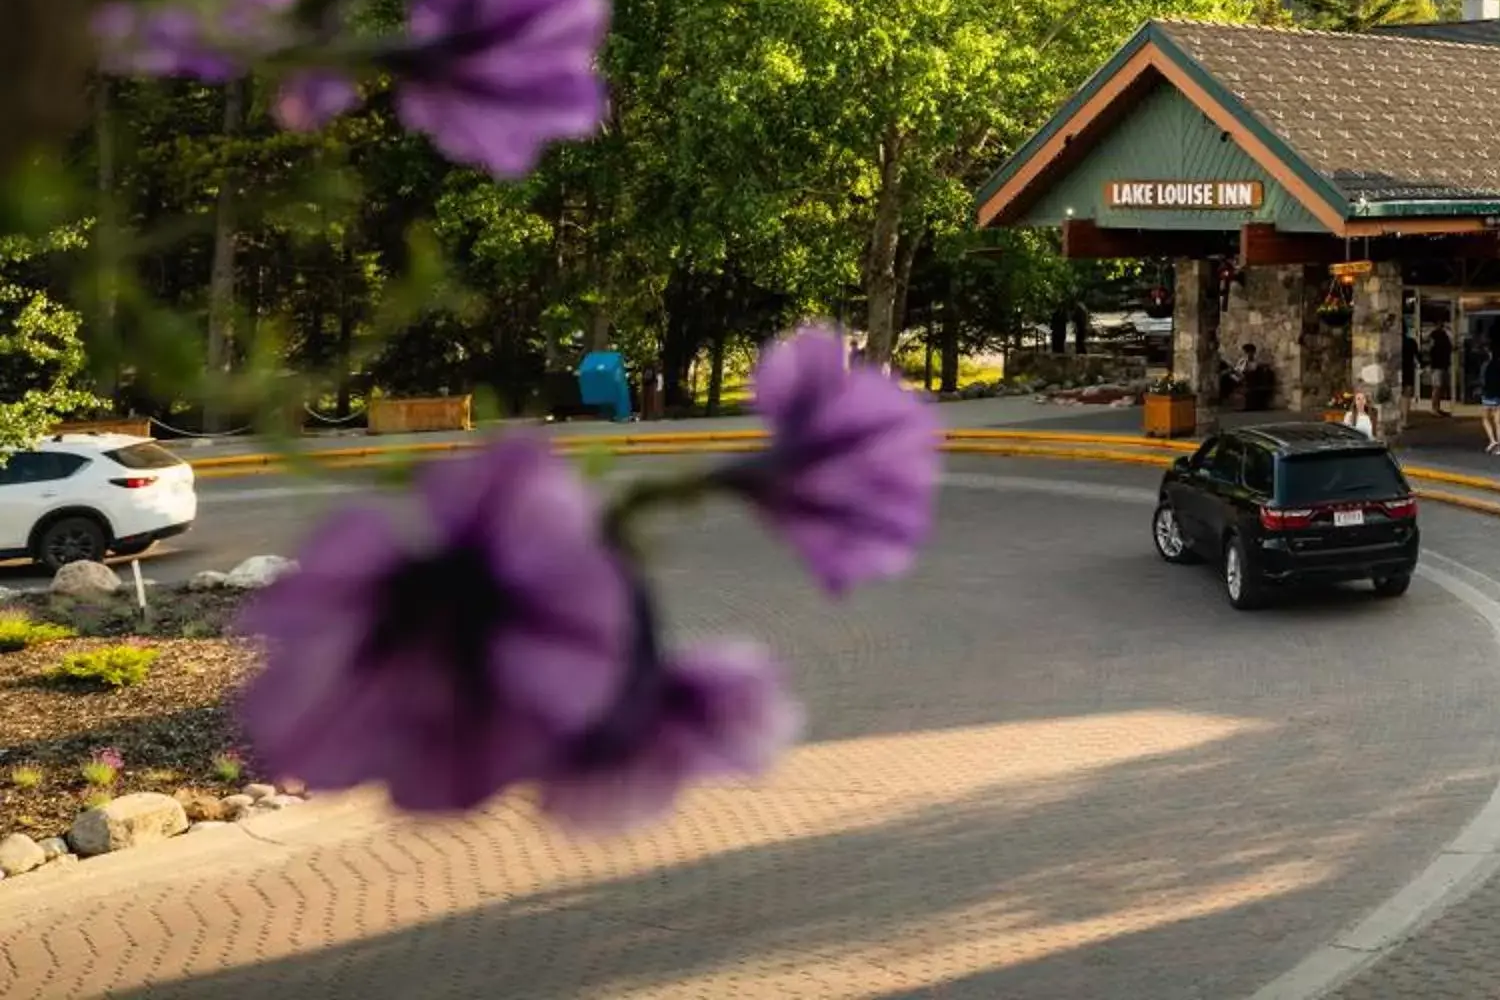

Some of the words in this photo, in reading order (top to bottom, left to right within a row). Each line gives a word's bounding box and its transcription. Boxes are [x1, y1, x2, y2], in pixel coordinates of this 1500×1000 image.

[1112, 183, 1153, 205] LAKE
[1157, 183, 1213, 205] LOUISE
[1217, 183, 1252, 205] INN
